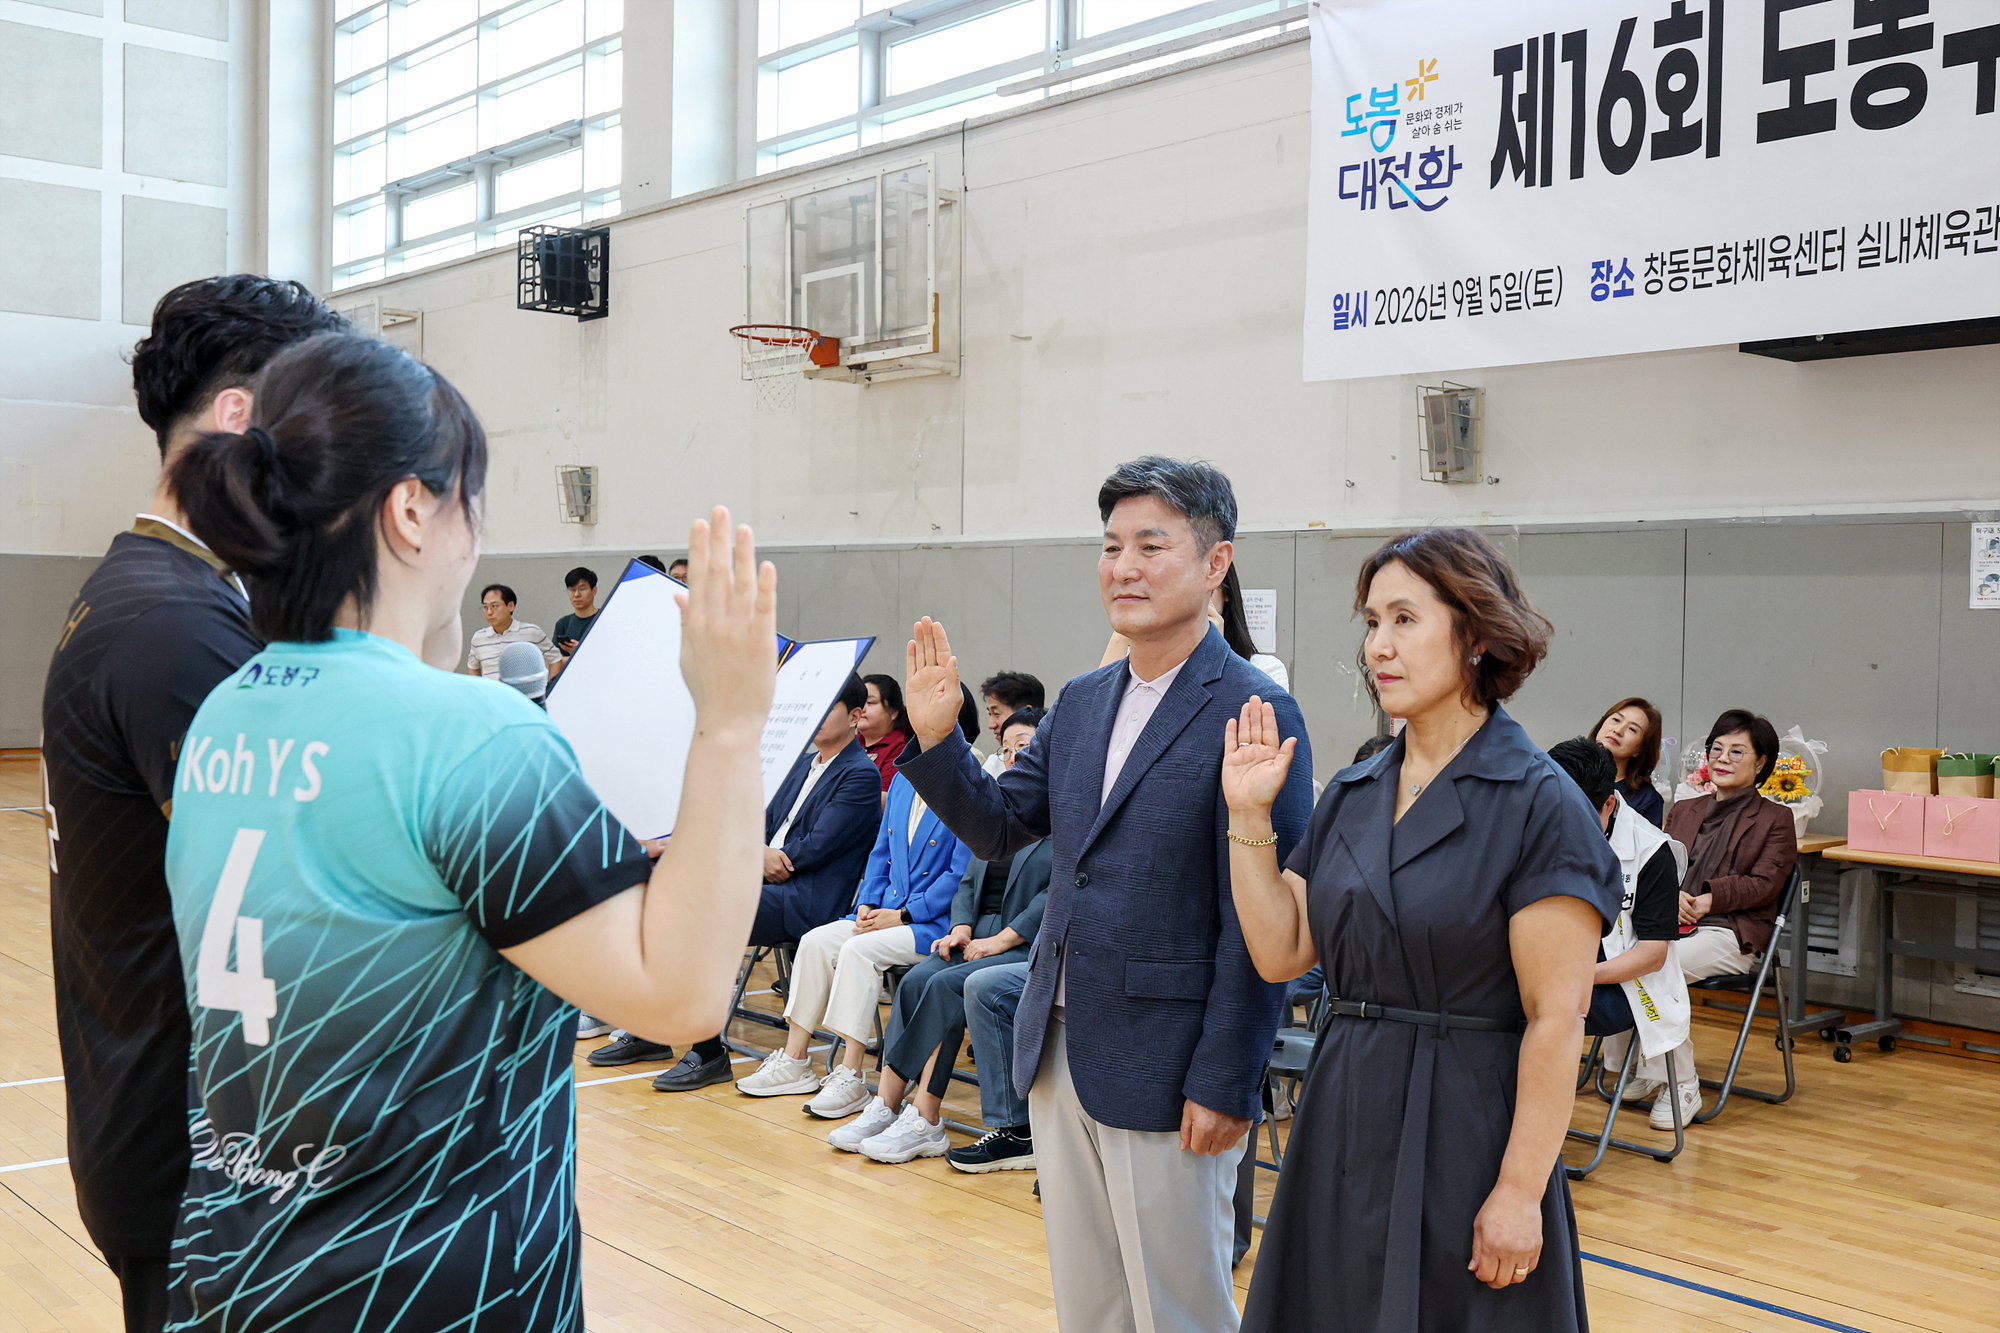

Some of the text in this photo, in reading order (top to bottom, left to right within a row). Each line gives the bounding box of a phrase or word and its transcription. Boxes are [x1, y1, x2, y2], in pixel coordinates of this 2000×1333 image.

[1341, 83, 1401, 153] 도봉
[1405, 102, 1464, 126] 문화와 경제가
[1411, 118, 1463, 139] 살아 숨 쉬는
[1490, 0, 1725, 190] 제16회
[1339, 144, 1463, 212] 대전환
[1333, 204, 2000, 330] 일시 2026년 9월 5일(토) 장소 창동문화체육센터 실내체육관
[263, 665, 321, 688] 도봉구
[182, 732, 256, 796] Koh
[267, 737, 296, 798] Y
[293, 740, 331, 803] S
[197, 827, 278, 1047] 4
